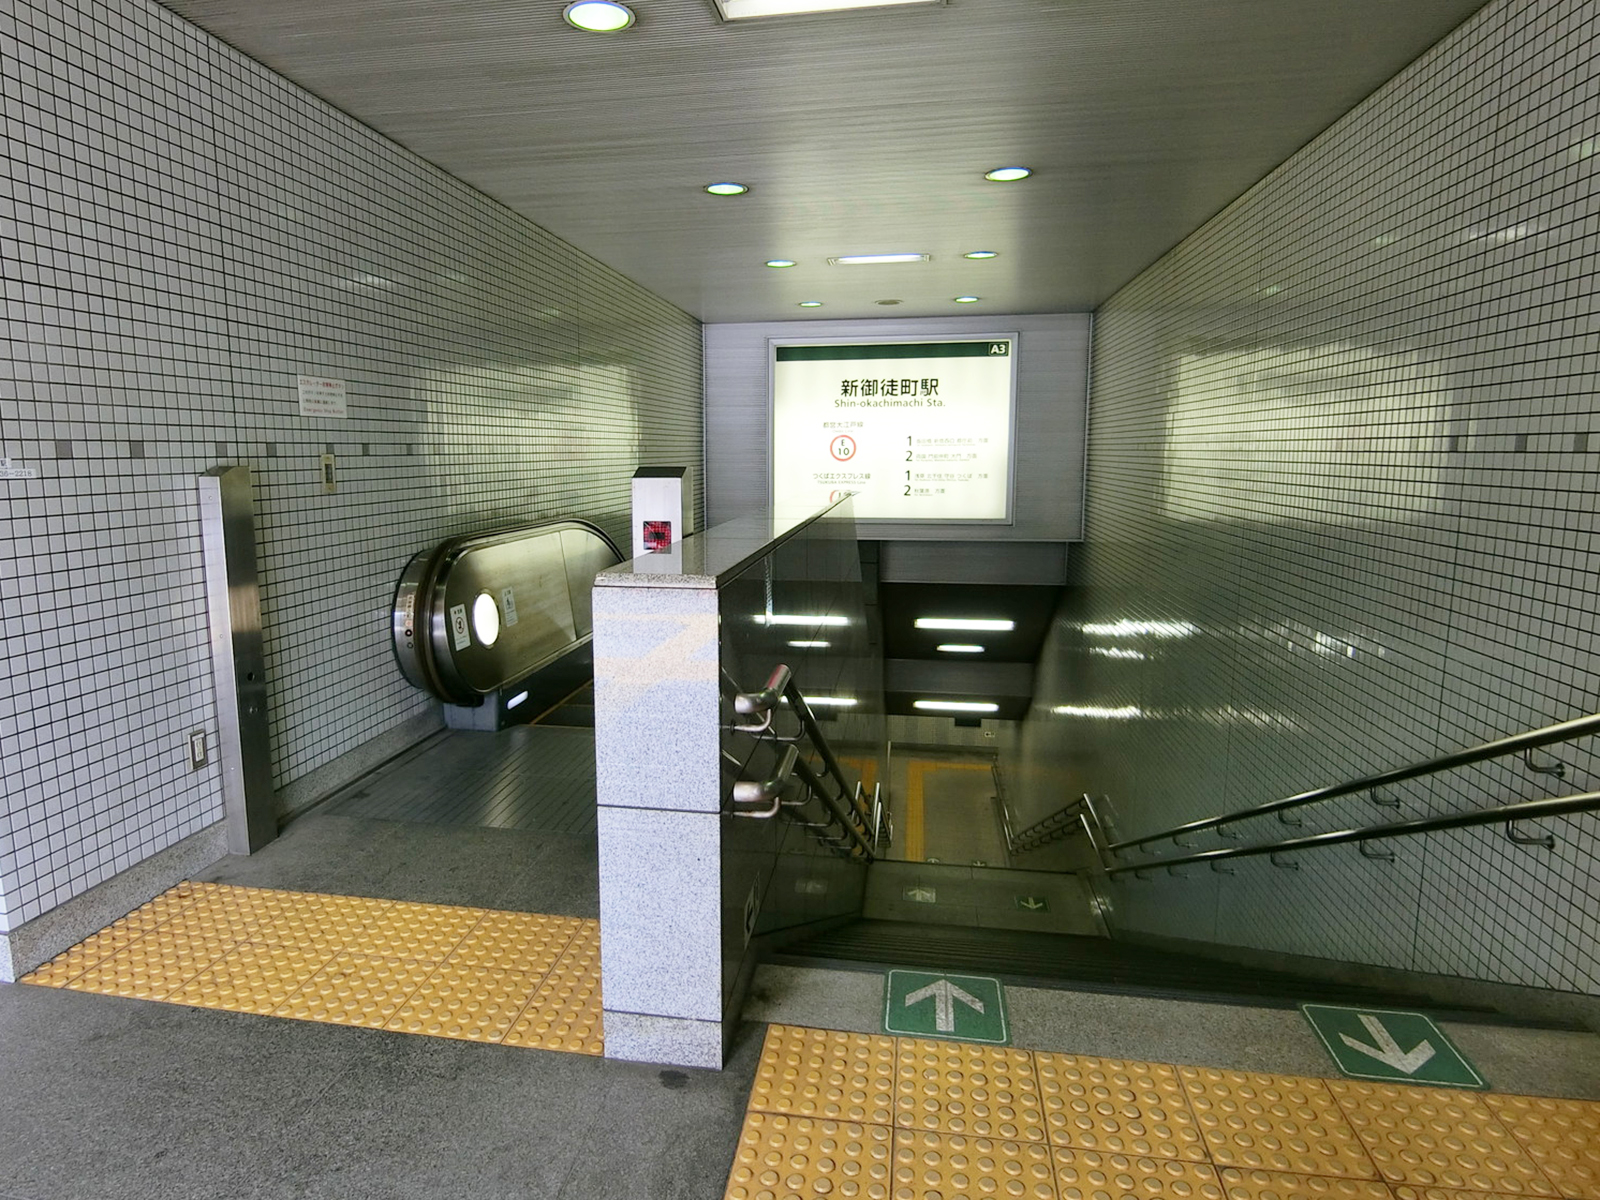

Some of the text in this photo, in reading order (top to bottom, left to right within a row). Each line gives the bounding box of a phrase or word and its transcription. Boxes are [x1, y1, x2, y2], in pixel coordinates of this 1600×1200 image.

[990, 343, 1006, 355] A3
[840, 378, 939, 397] 新御徒町駅
[834, 398, 946, 408] Shin-okachimachi Sta.
[906, 435, 912, 447] 1
[838, 447, 850, 456] 10
[905, 450, 913, 462] 2
[905, 470, 911, 481] 1
[903, 484, 911, 497] 2
